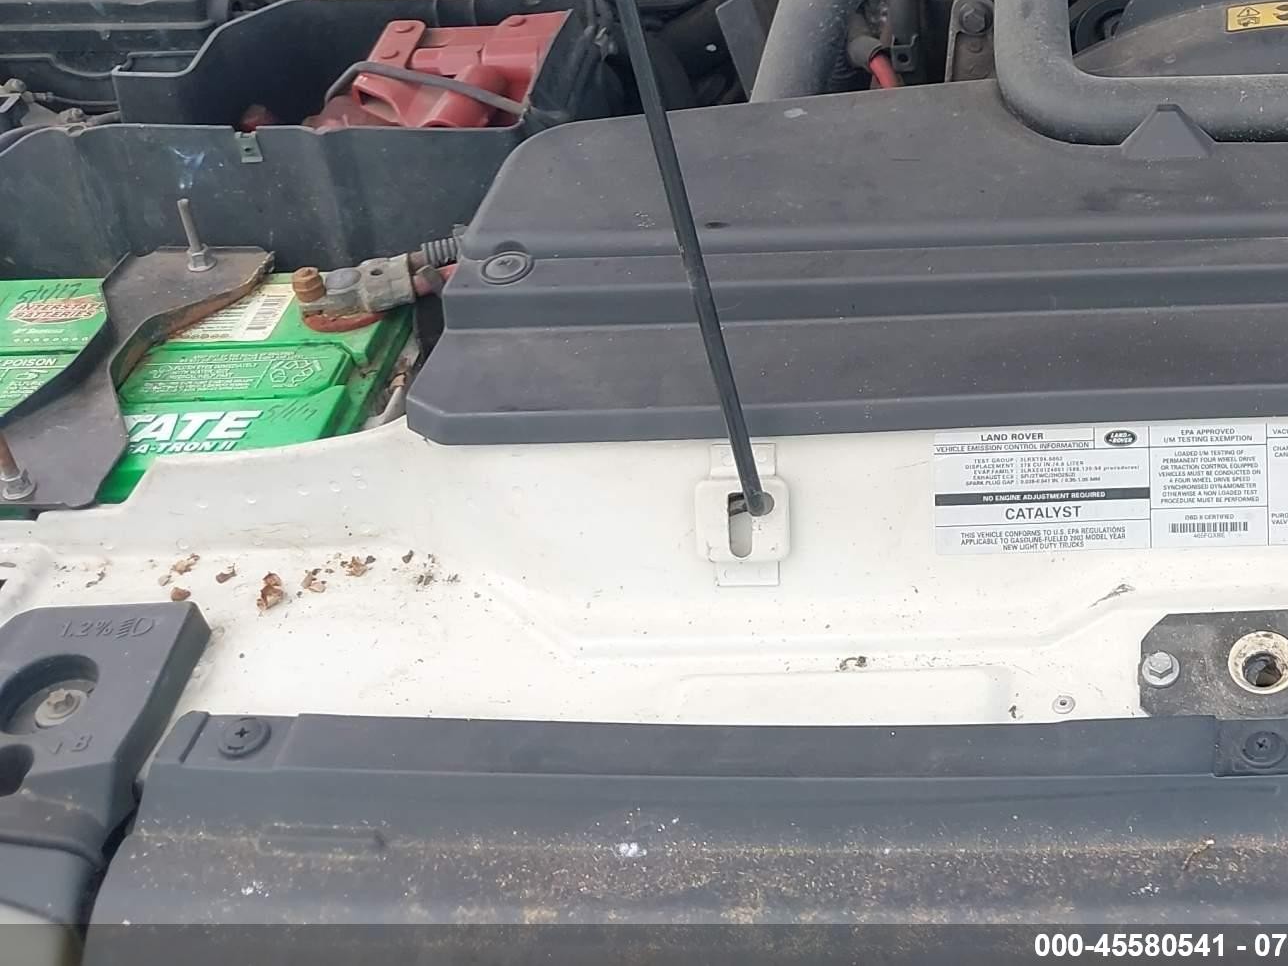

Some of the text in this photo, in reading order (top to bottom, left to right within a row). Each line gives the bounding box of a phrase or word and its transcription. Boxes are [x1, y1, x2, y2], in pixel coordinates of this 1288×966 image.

[3, 358, 57, 366] POISON
[981, 432, 1044, 442] LAND ROVER
[130, 442, 216, 454] A-TRON
[936, 441, 1090, 453] VEHICLE EMISSION CONTROL INFORMATION
[1005, 506, 1082, 520] CATALYST
[961, 538, 998, 546] APPLICABLE
[1010, 535, 1068, 544] GASOLINE-FUELED
